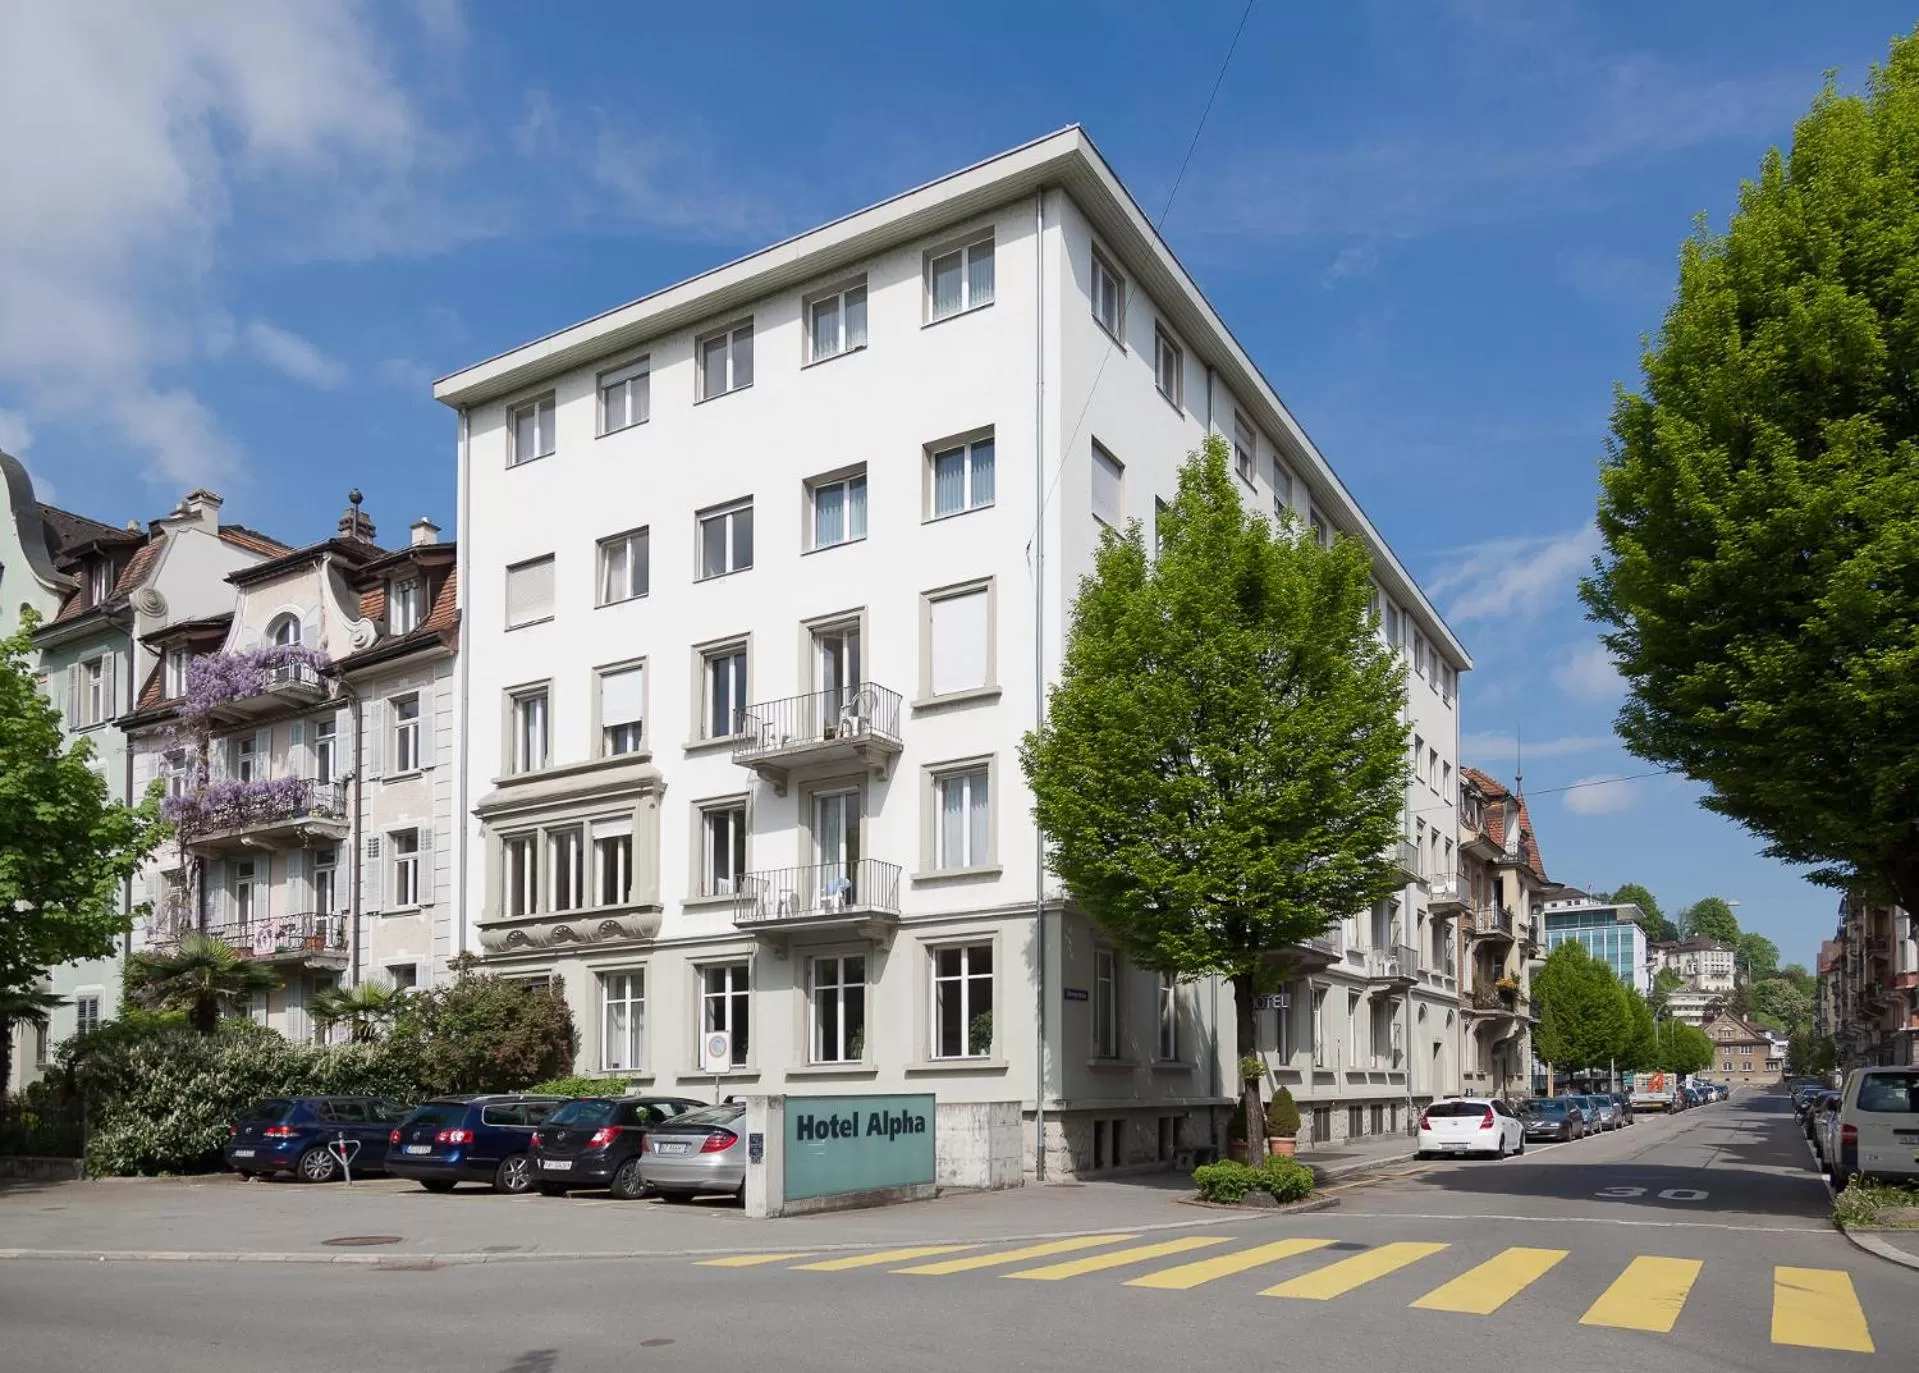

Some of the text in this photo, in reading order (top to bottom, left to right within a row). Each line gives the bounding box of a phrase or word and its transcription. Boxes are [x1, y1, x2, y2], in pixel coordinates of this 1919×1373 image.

[797, 1109, 926, 1142] Hotel Alpha
[1594, 1186, 1710, 1201] 30
